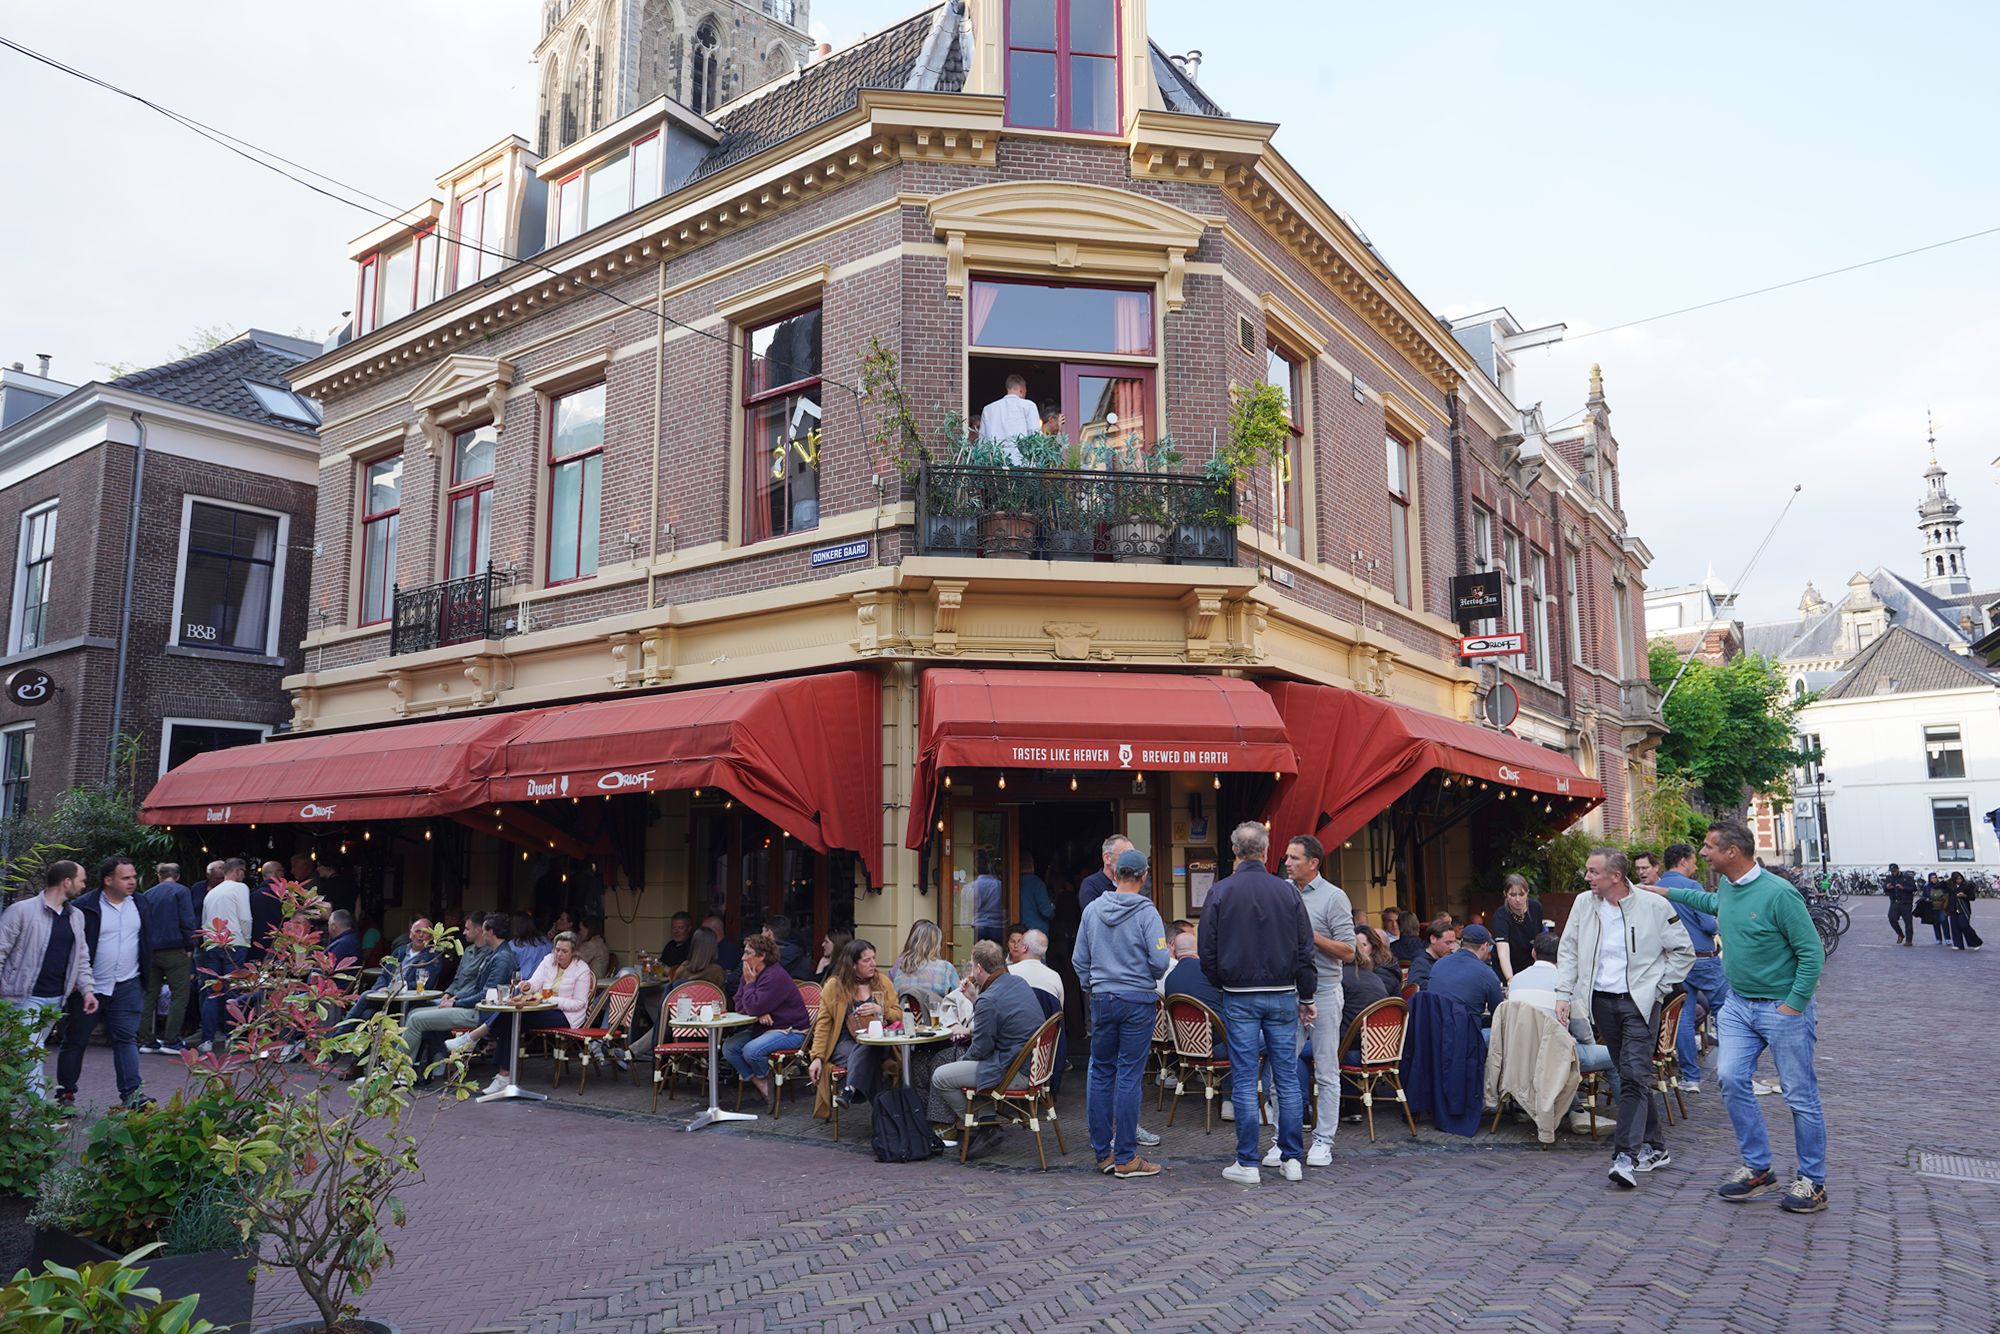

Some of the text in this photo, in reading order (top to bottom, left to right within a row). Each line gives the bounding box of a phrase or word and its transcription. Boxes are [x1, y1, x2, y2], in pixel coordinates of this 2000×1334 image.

[813, 544, 866, 563] DONKERE GAARD
[1460, 595, 1497, 607] Hertog Jan
[186, 624, 217, 640] B&B
[1012, 747, 1109, 762] TASTES LIKE HEAVEN
[1142, 750, 1228, 764] BREWED ON EARTH
[527, 778, 557, 796] Duvel
[597, 769, 657, 789] ORLOFF
